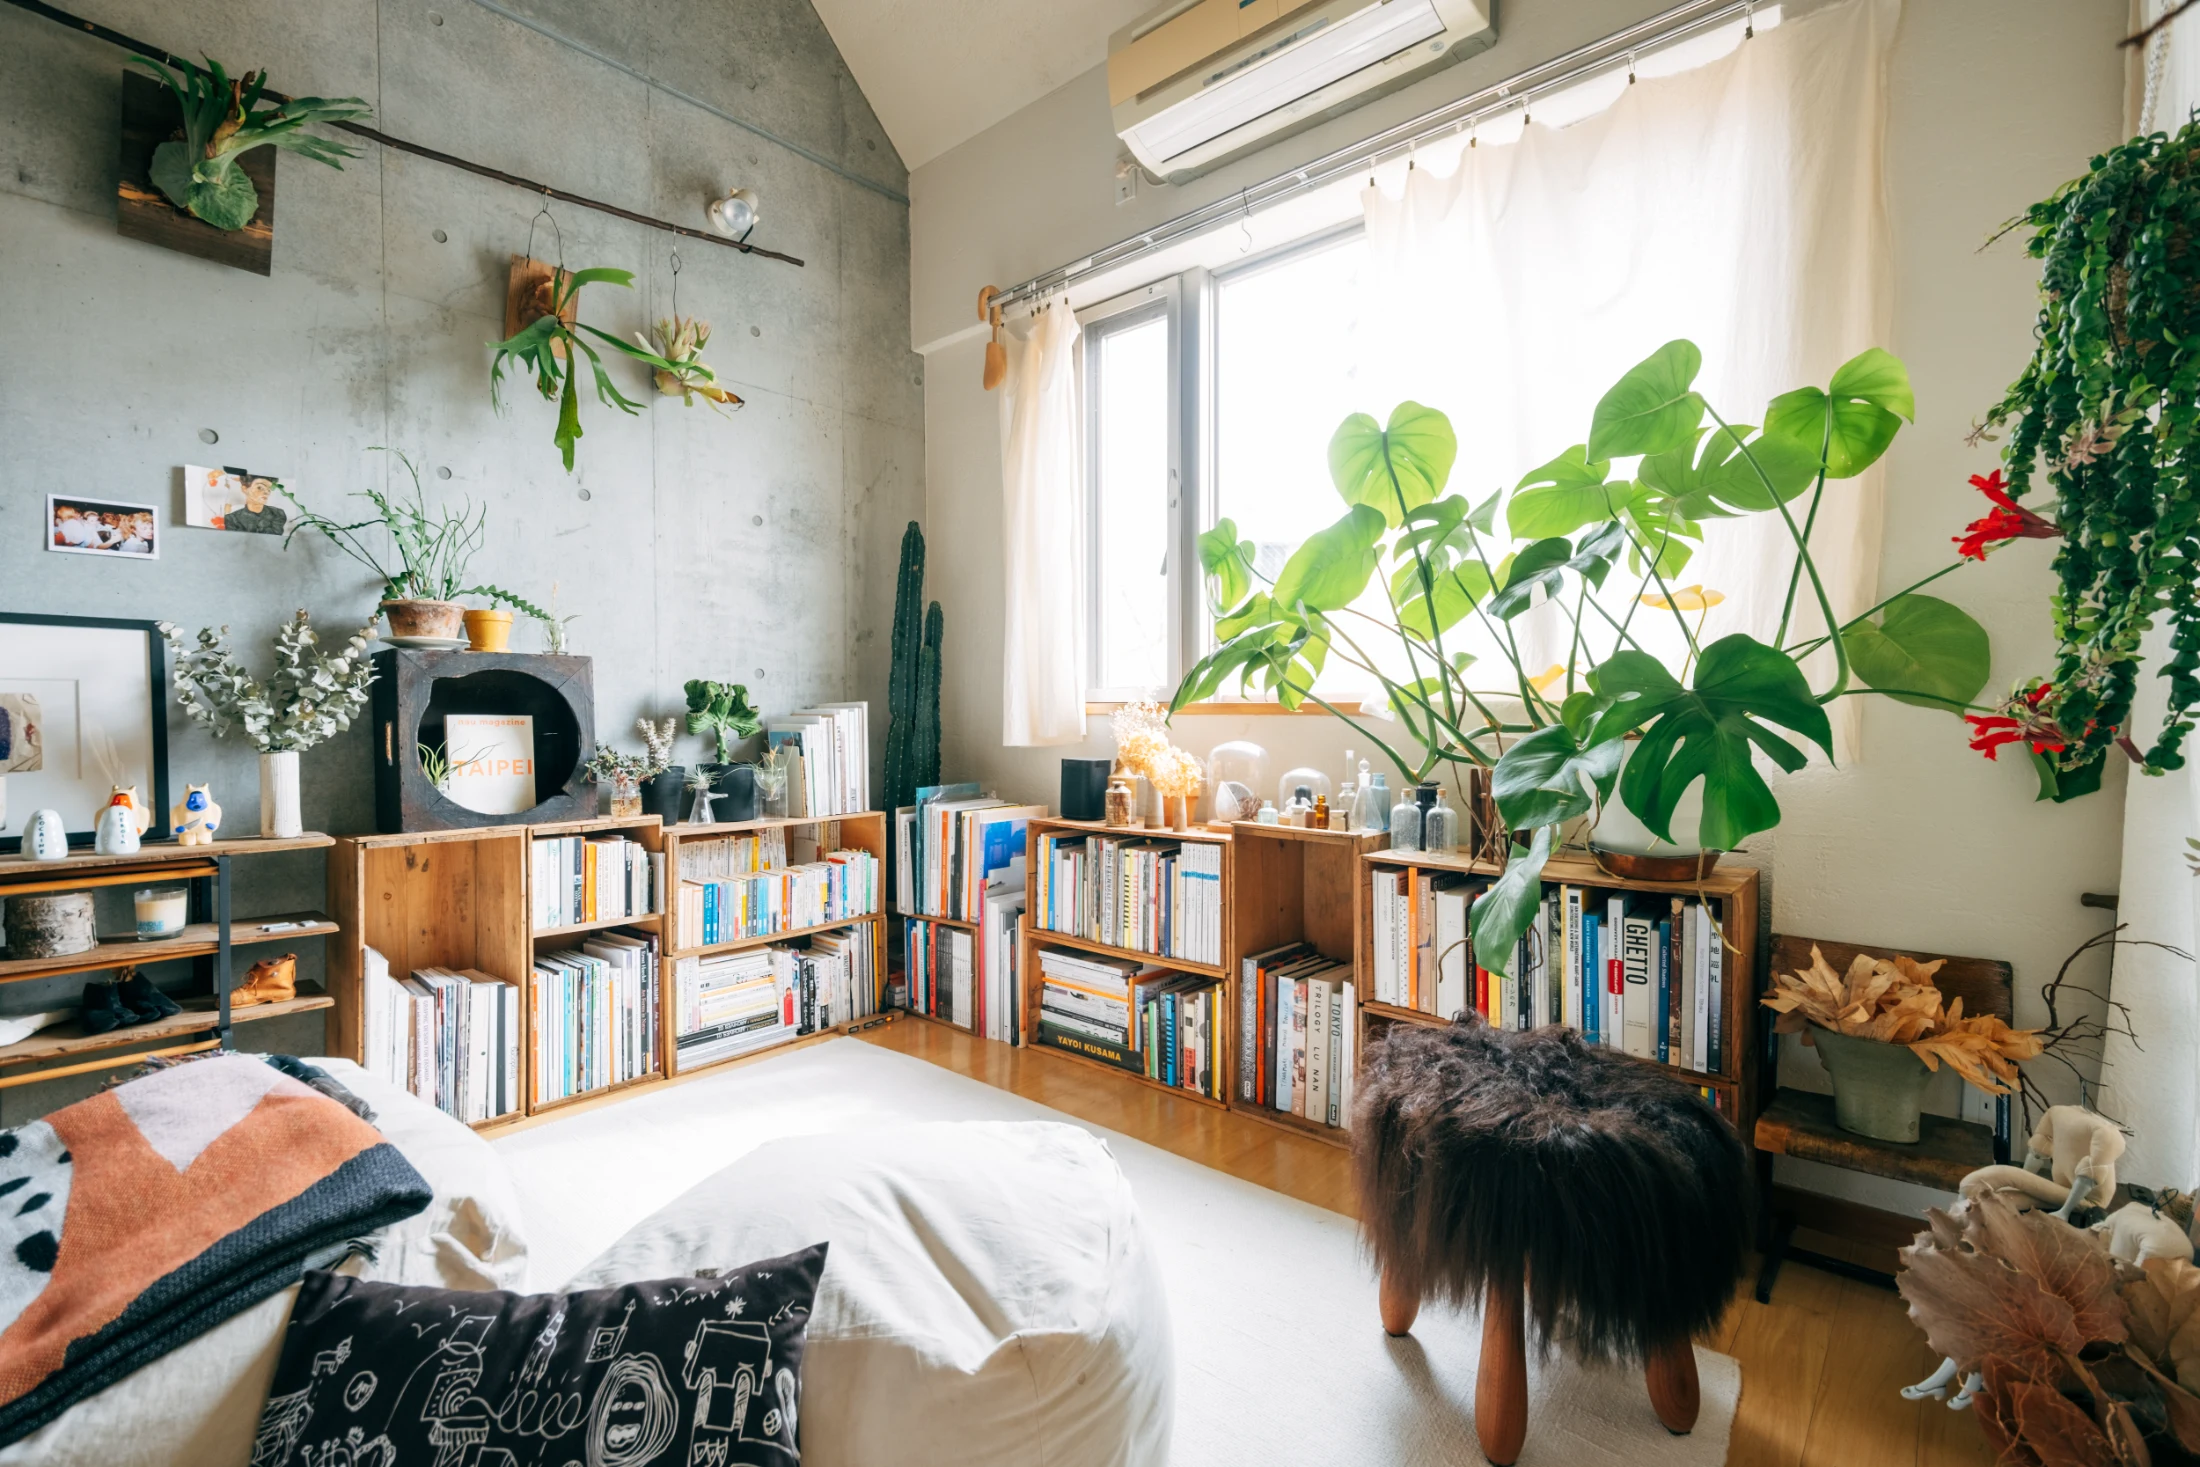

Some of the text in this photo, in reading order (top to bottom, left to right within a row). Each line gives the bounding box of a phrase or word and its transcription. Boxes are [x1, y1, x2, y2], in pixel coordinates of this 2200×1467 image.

[479, 718, 526, 728] magazine
[452, 758, 533, 777] TAIPEI
[37, 814, 46, 855] COCAINE
[118, 812, 126, 844] HEROIN
[1625, 923, 1649, 986] GHETTO
[1314, 986, 1322, 1034] TRILOGY
[1331, 1003, 1341, 1037] TOKYO
[1057, 1035, 1122, 1062] YAYOI KUSAMA
[1313, 1047, 1320, 1061] LU
